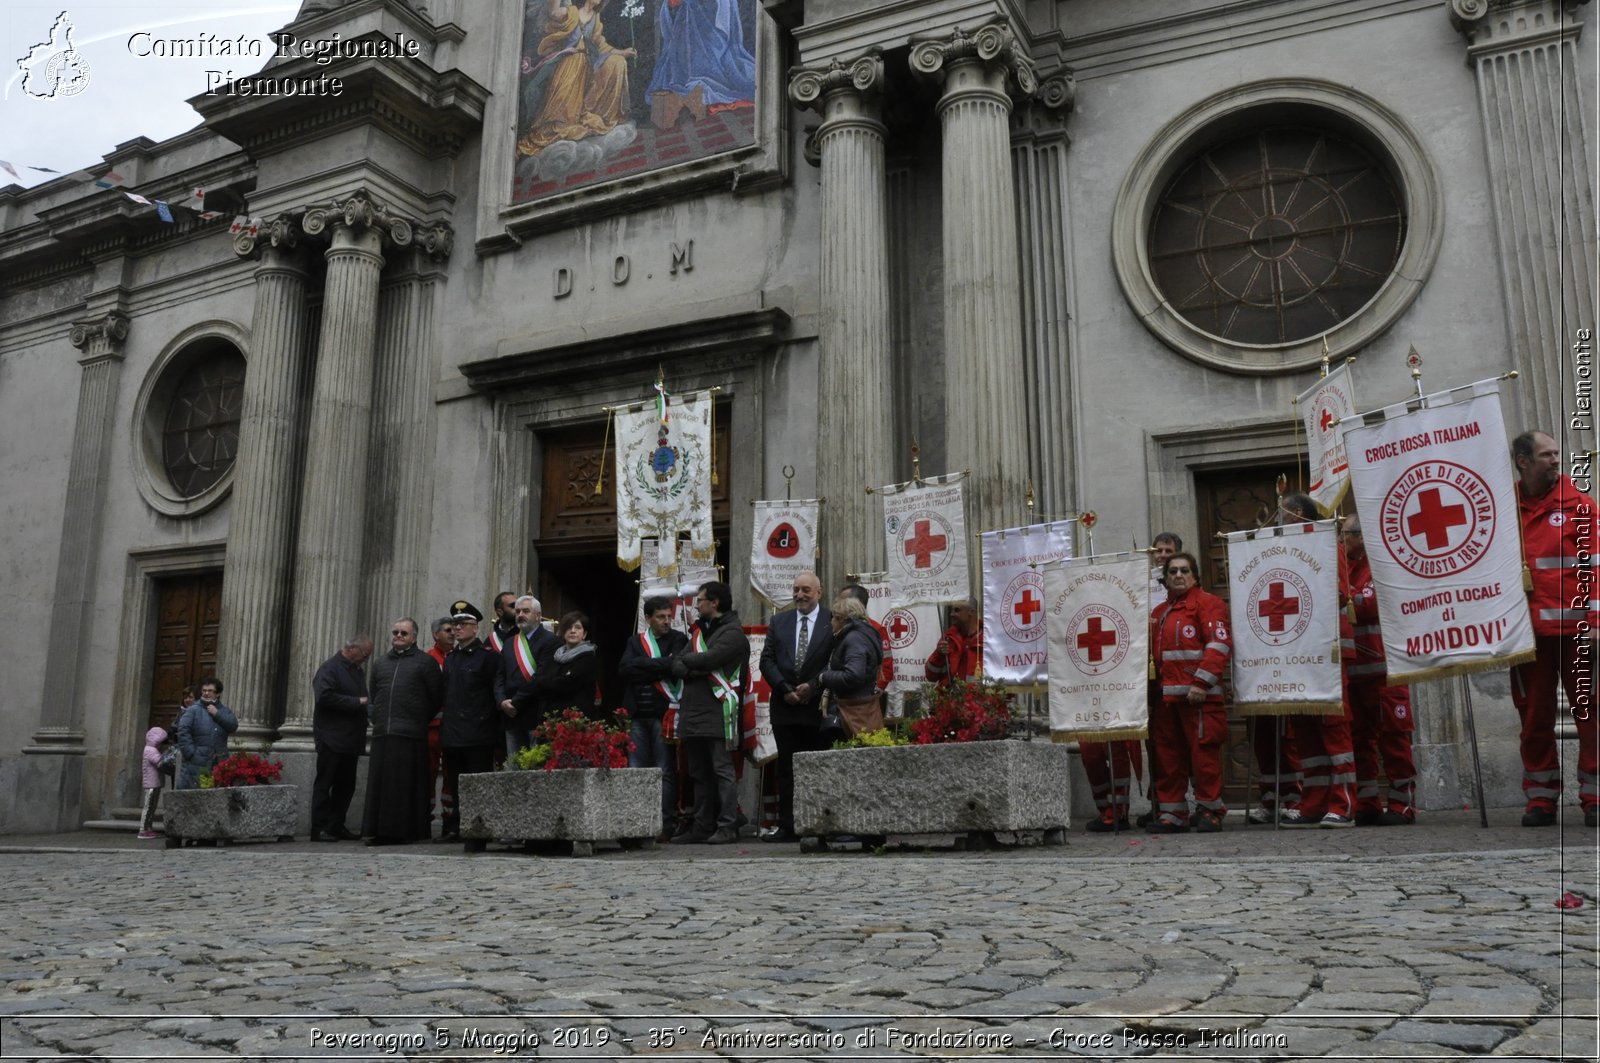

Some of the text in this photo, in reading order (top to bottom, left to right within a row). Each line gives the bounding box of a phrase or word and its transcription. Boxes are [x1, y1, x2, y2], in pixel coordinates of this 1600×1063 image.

[1365, 421, 1481, 463] CROCE ROSSA ITALIANA
[908, 501, 931, 511] ROSSA
[932, 495, 961, 507] ITALIANA
[1385, 465, 1492, 543] CONVENZIONE DI GINEVRA
[991, 559, 1013, 569] CROCE
[1033, 551, 1065, 561] ITALIANA
[1238, 546, 1323, 584] CROCE ROSSA ITALIANA
[1404, 540, 1483, 575] 22 AGOSTO 1864
[867, 587, 883, 599] ROCE
[1053, 572, 1140, 616] CROCE ROSSA ITALIANA
[1293, 576, 1303, 587] 22
[1300, 585, 1311, 618] AGOSTO
[1401, 582, 1501, 615] COMITATO LOCALE
[1442, 607, 1455, 621] di
[1082, 606, 1110, 617] GINEVRA
[1110, 611, 1119, 621] 22
[1117, 619, 1128, 650] AGOSTO
[1406, 618, 1507, 658] MONDOVI'
[900, 657, 926, 666] LOCALE
[1242, 655, 1324, 668] COMITATO LOCALE
[1273, 670, 1282, 678] DI
[1060, 682, 1136, 694] COMITATO LOCALE
[1257, 683, 1306, 694] DRONERO
[1092, 697, 1101, 706] DI
[1076, 711, 1121, 722] BUSCA
